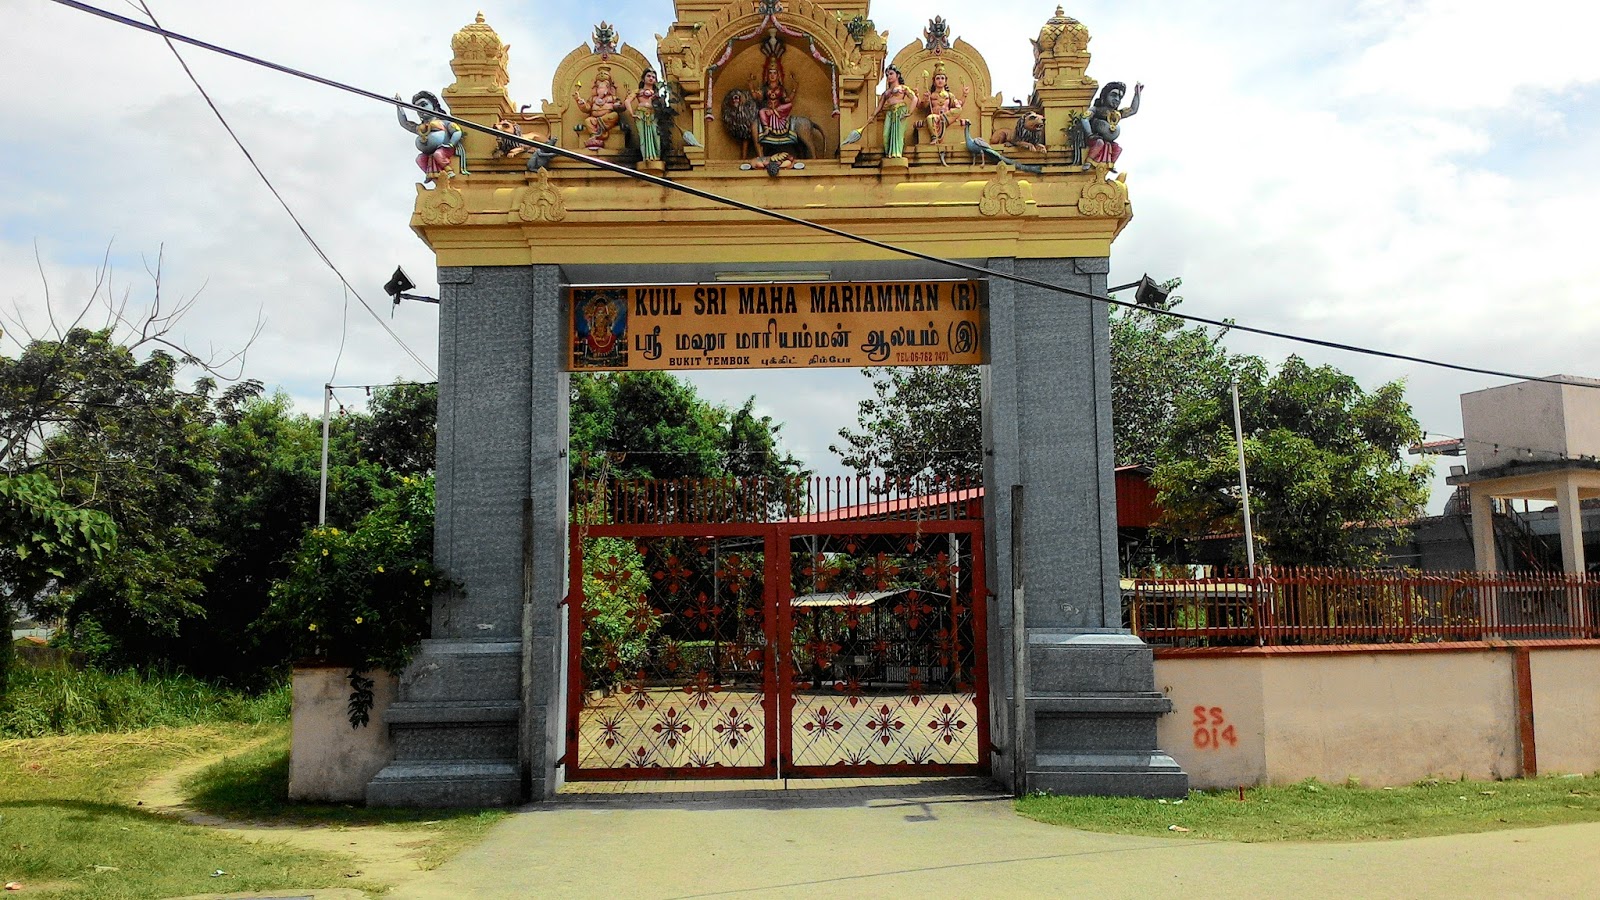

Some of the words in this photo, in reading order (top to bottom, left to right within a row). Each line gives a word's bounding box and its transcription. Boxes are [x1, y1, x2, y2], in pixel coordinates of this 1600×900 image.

[635, 288, 682, 316] KUIL
[694, 287, 727, 315] SRI
[738, 286, 797, 314] MAHA
[810, 284, 939, 313] MARIAMMAN
[951, 283, 978, 311] (R)
[736, 317, 851, 350] மாரியம்மன்
[861, 321, 940, 362] ஆலயம்
[947, 320, 979, 354] (இ)
[669, 357, 701, 366] BUKIT
[706, 356, 750, 365] TEMBOK
[1192, 705, 1224, 726] SS
[1192, 724, 1238, 750] 014
